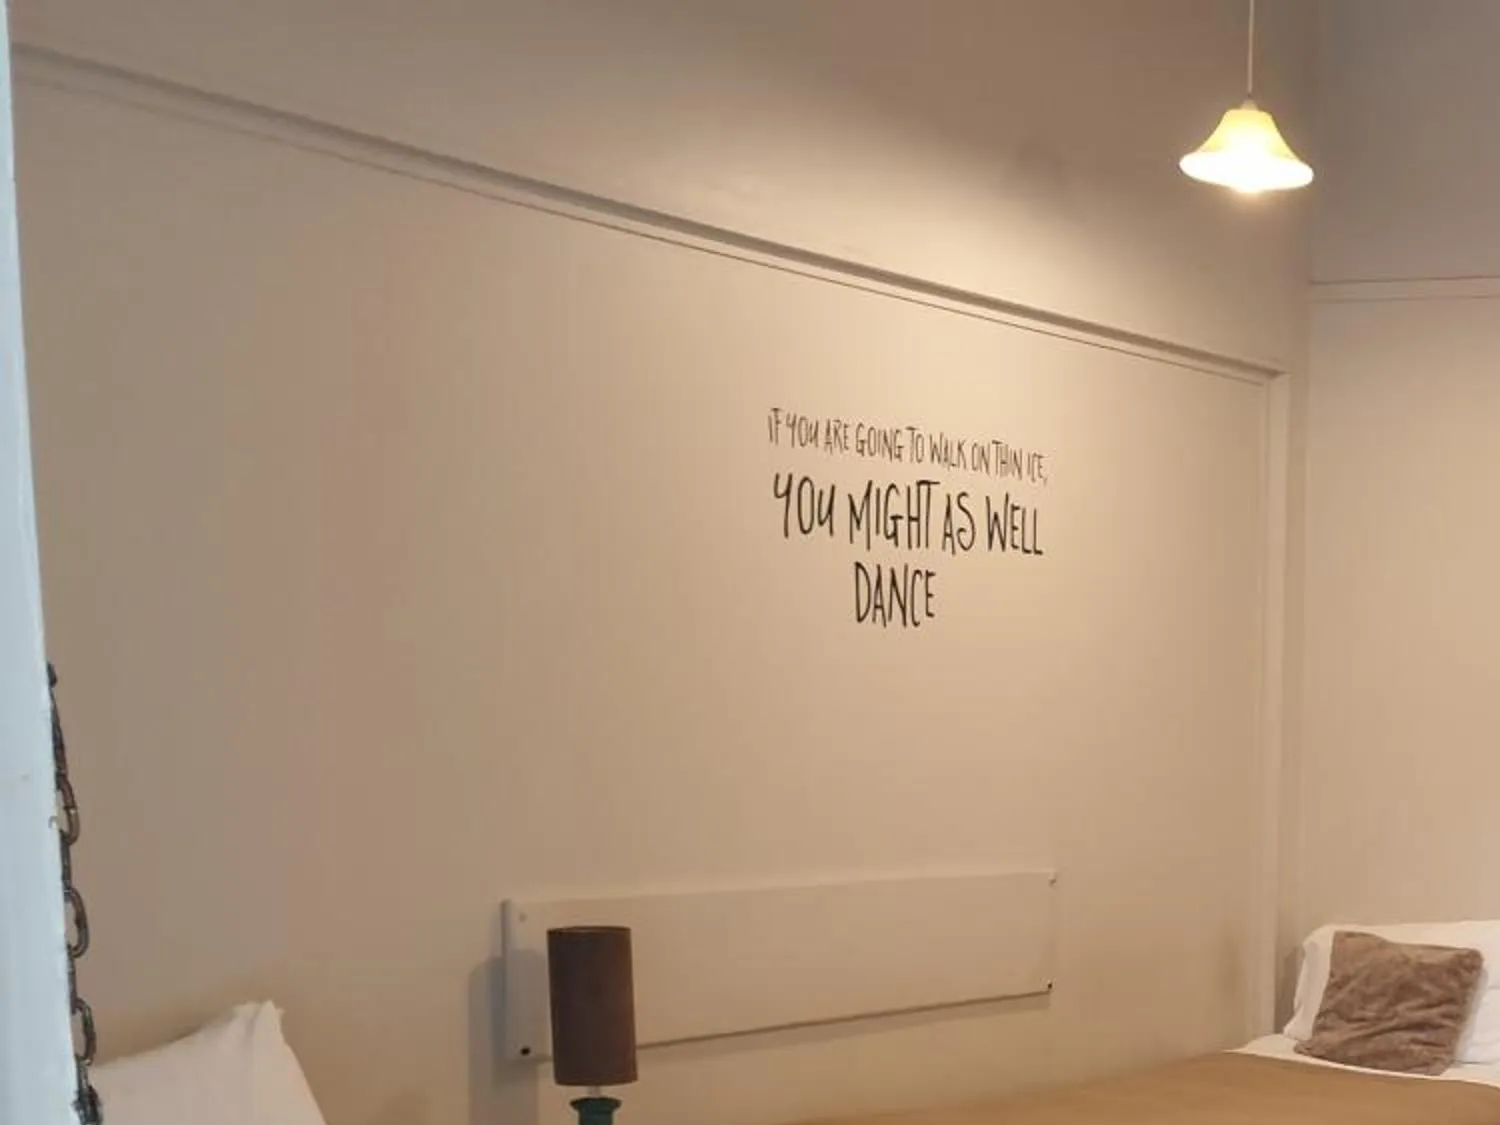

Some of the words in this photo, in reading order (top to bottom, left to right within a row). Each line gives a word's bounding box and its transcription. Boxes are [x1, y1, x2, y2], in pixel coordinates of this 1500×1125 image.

[768, 407, 782, 445] IF
[786, 413, 819, 450] YOU
[824, 418, 850, 454] ARE
[855, 422, 904, 462] GOING
[906, 426, 925, 463] TO
[929, 432, 967, 471] WALK
[971, 442, 991, 478] ON
[992, 440, 1023, 480] THIN
[773, 472, 836, 539] YOU
[848, 479, 941, 551] MIGHT
[941, 491, 977, 555] AS
[985, 492, 1044, 555] WELL
[854, 561, 937, 628] DANCE
